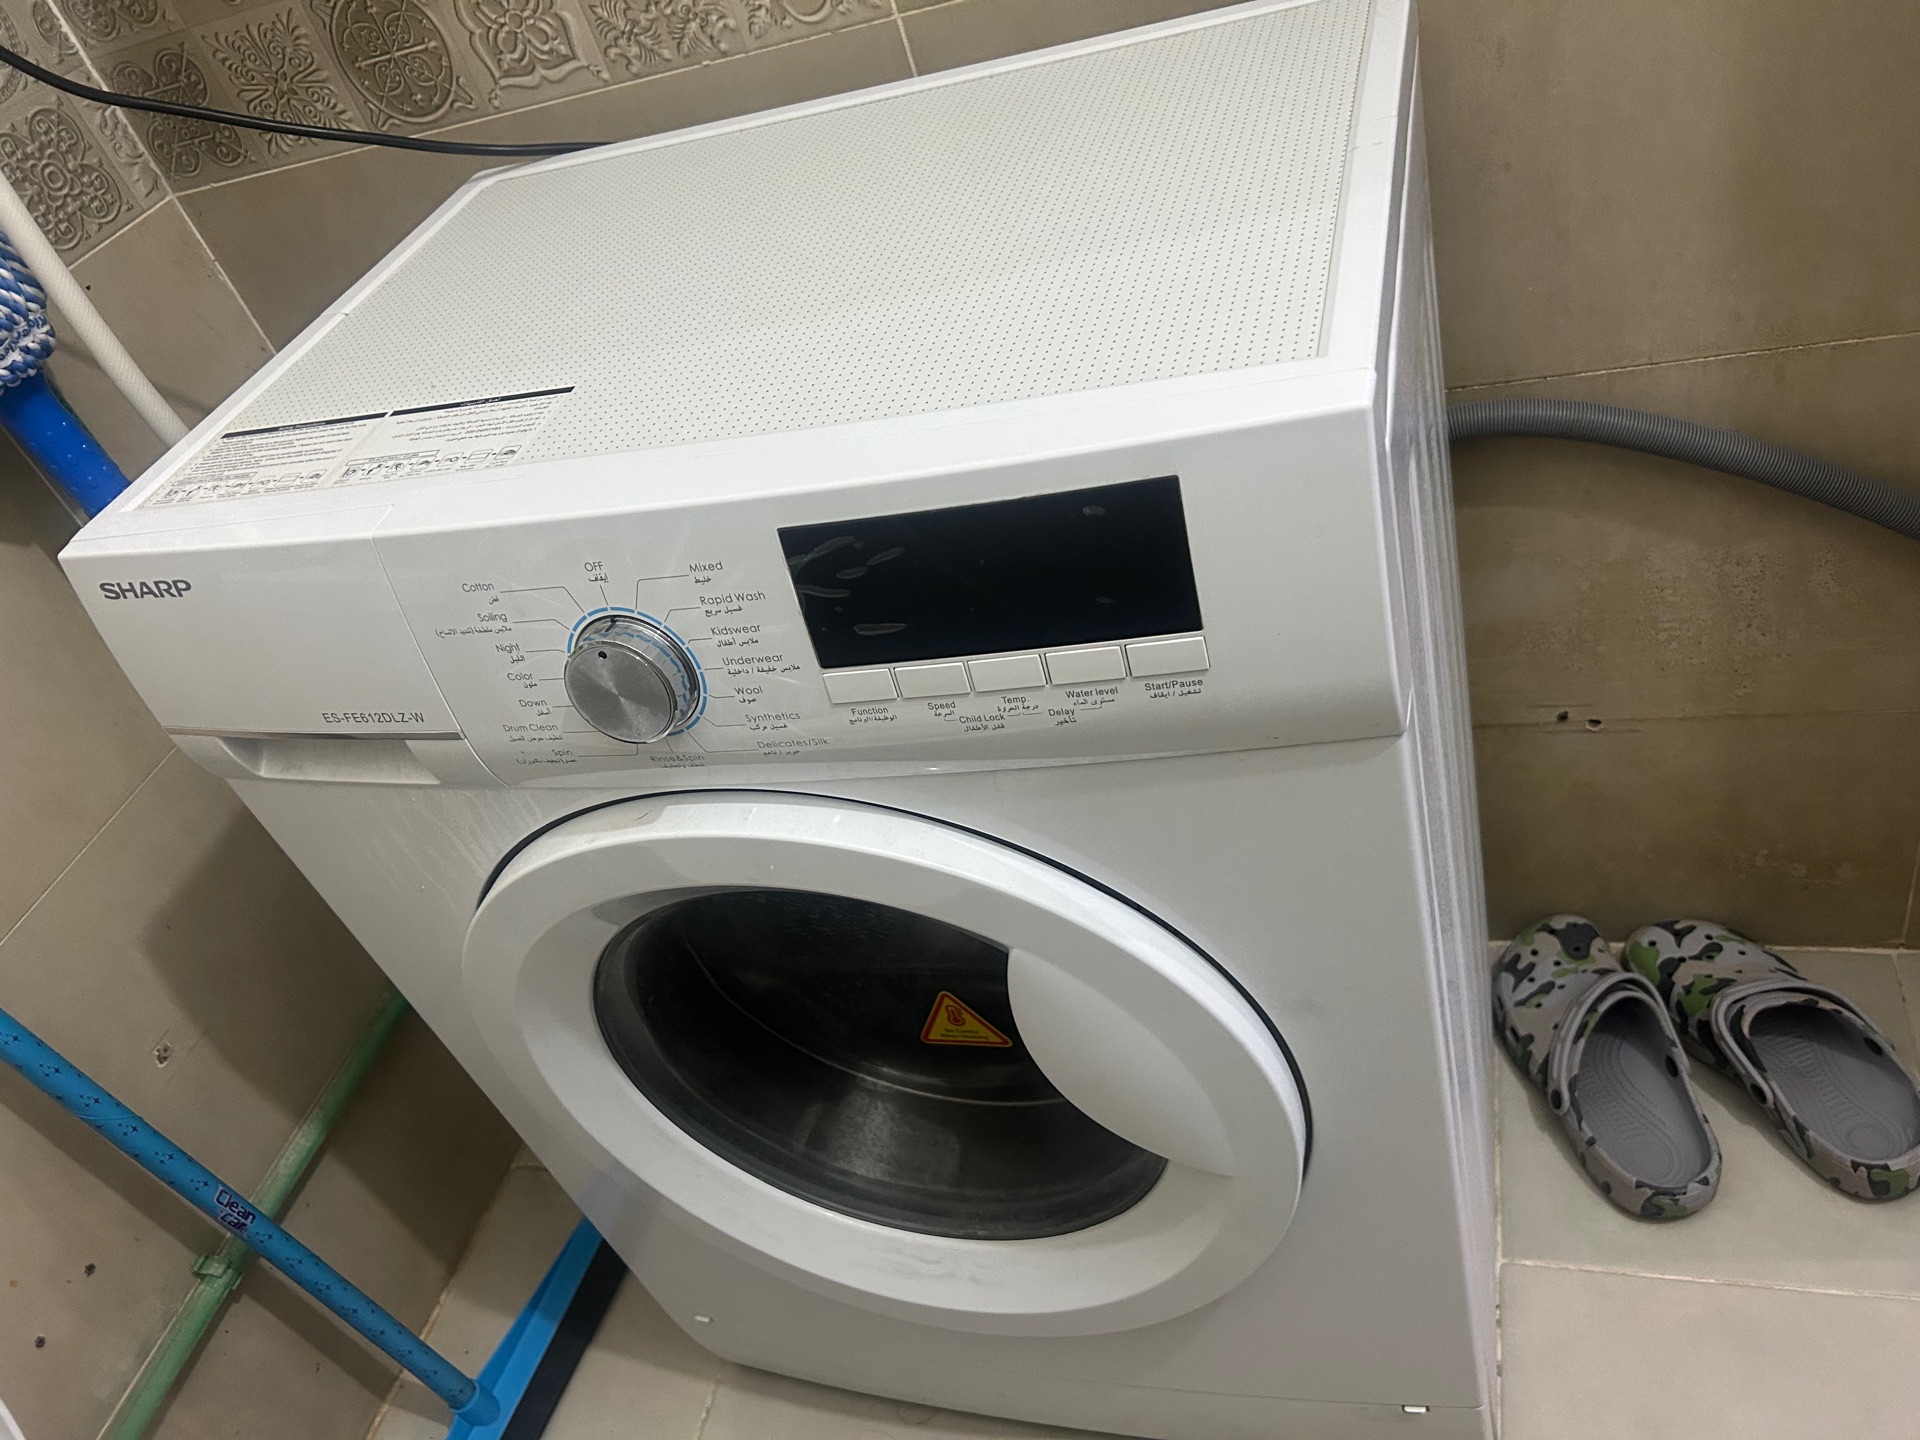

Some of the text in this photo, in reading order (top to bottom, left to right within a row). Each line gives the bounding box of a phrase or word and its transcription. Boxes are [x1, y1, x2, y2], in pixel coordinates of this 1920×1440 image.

[584, 561, 603, 572] OFF
[689, 560, 723, 573] Mixed
[99, 579, 192, 600] SHARP
[462, 582, 495, 593] Cotton
[699, 590, 766, 606] Rapid Wash
[477, 613, 508, 623] Soiling
[710, 624, 761, 636] Kidswear
[495, 643, 521, 654] Night
[721, 654, 784, 666] Underwear
[506, 672, 533, 681] Color
[734, 685, 763, 695] Wool
[1144, 679, 1204, 691] Start/Pause
[1065, 686, 1118, 699] Water level
[518, 699, 548, 708] Down
[927, 701, 956, 711] Speed
[851, 707, 889, 716] Function
[1048, 708, 1075, 718] Delay
[321, 712, 425, 723] ES-FE612DLZ-W
[745, 712, 801, 724] Synthetics
[959, 712, 1006, 724] Child Lock
[502, 723, 559, 733] Drum Clean
[756, 737, 831, 749] Delicates/Silk
[552, 748, 573, 757] Spin
[649, 754, 705, 764] Rinse&Spin
[215, 1189, 257, 1224] Clean
